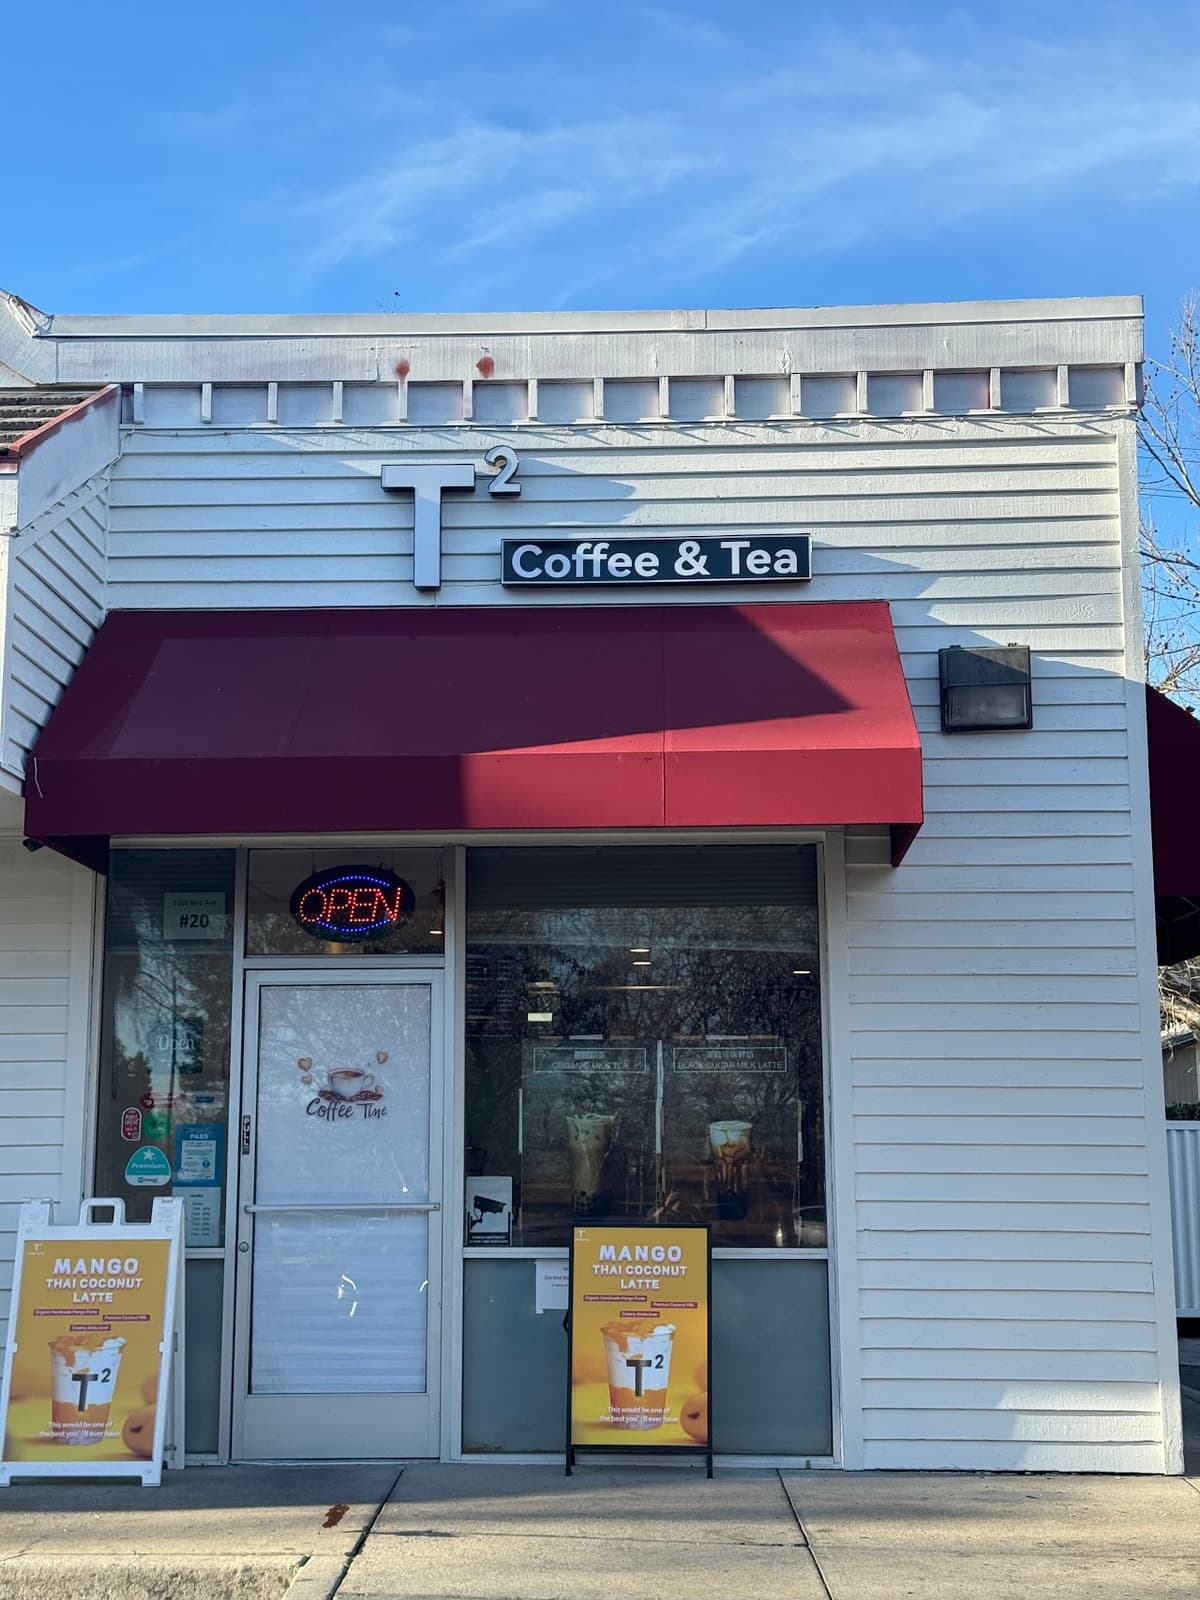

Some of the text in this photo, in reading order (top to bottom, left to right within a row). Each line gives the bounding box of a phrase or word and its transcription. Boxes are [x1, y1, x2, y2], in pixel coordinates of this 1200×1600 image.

[511, 540, 799, 579] Coffee & Tea
[299, 886, 402, 924] OPEN
[179, 913, 210, 929] #20
[156, 1033, 196, 1051] Open
[705, 1061, 735, 1070] SUGAR
[736, 1061, 757, 1069] MILK
[758, 1061, 783, 1069] LATTE
[305, 1098, 354, 1121] Coffee
[599, 1245, 683, 1263] MANGO
[53, 1257, 140, 1276] MANGO
[592, 1264, 688, 1277] THAI COCONUT
[46, 1277, 143, 1290] THAI COCONUT
[620, 1278, 660, 1290] LATTE
[72, 1291, 114, 1304] LATTE
[607, 1406, 620, 1414] This
[621, 1406, 641, 1414] would
[642, 1406, 651, 1414] be
